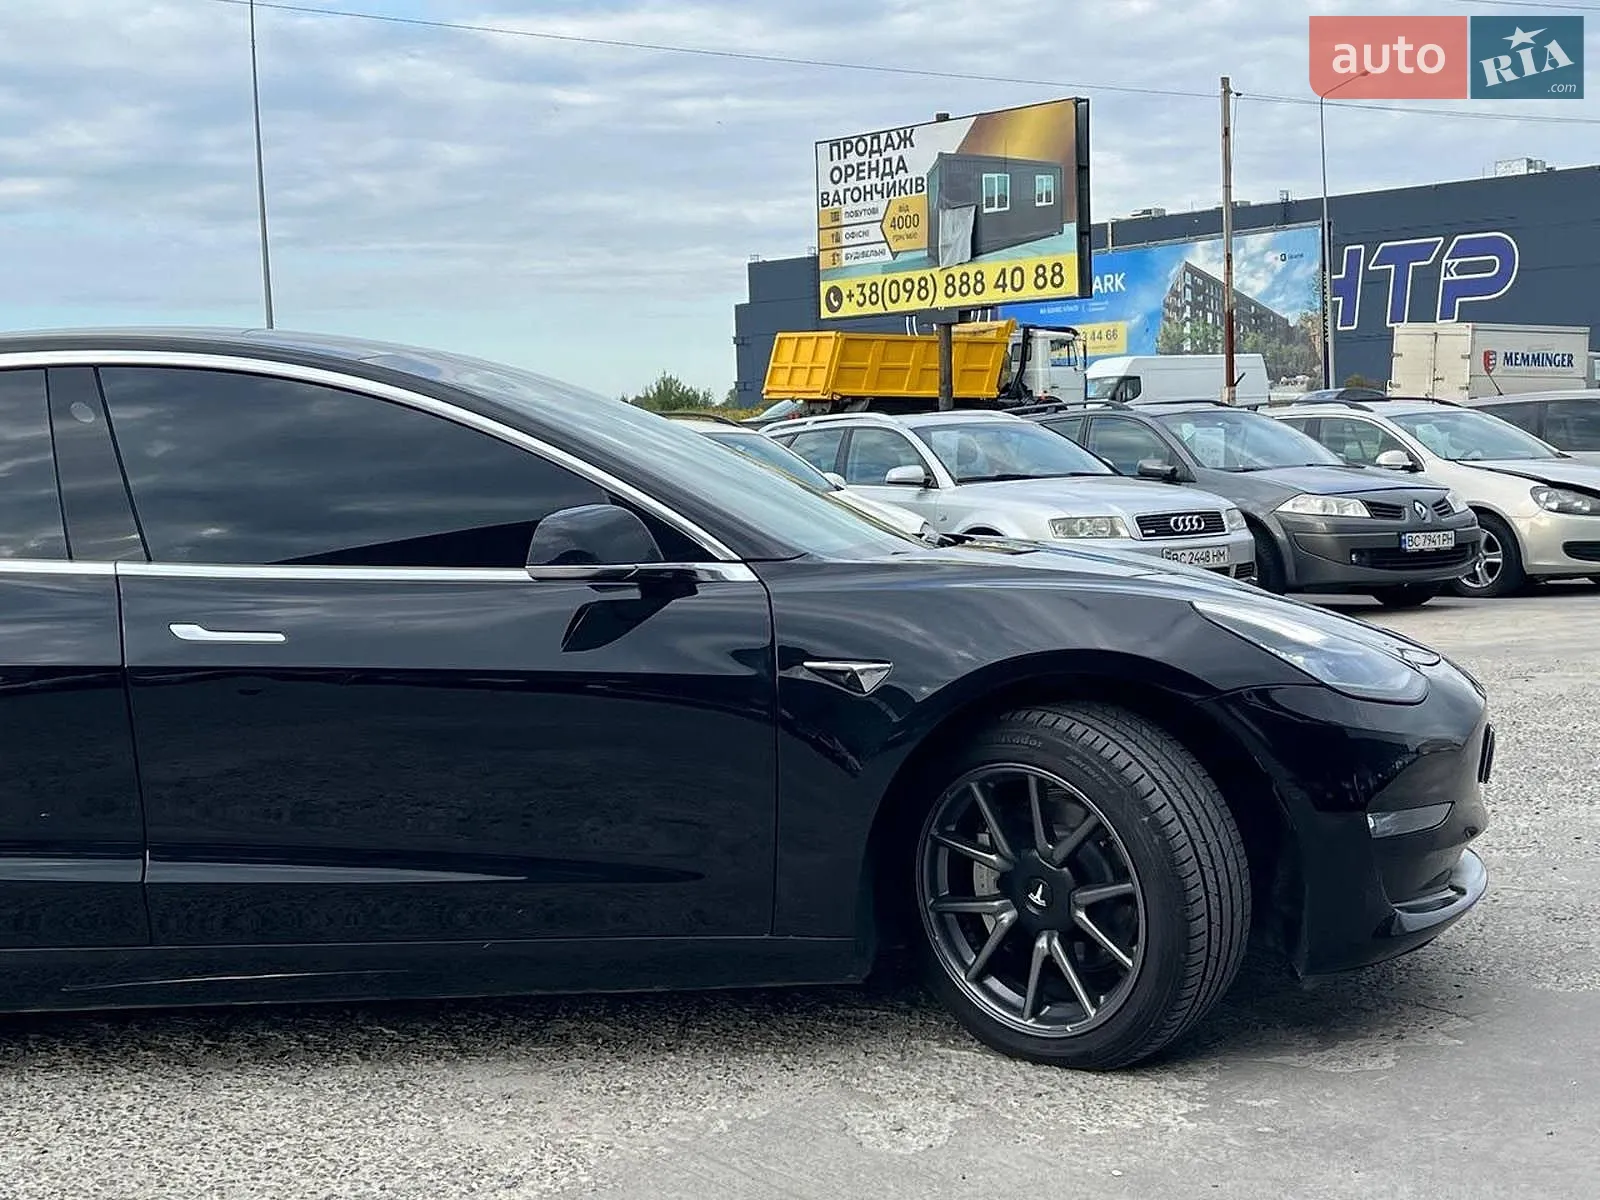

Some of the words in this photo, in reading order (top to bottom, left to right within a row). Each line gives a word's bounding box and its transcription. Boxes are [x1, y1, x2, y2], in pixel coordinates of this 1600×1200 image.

[829, 128, 915, 162] ПРОДАЖ
[829, 155, 909, 186] ОРЕНДА
[820, 176, 926, 208] ВАГОНЧИКІВ
[890, 213, 920, 231] 4000
[846, 273, 937, 311] +38(098)
[944, 269, 986, 299] 888
[993, 266, 1025, 293] 40
[1033, 262, 1065, 290] 88
[1503, 351, 1575, 368] MEMMINGER
[1407, 534, 1421, 547] BC
[1421, 533, 1442, 546] 7941
